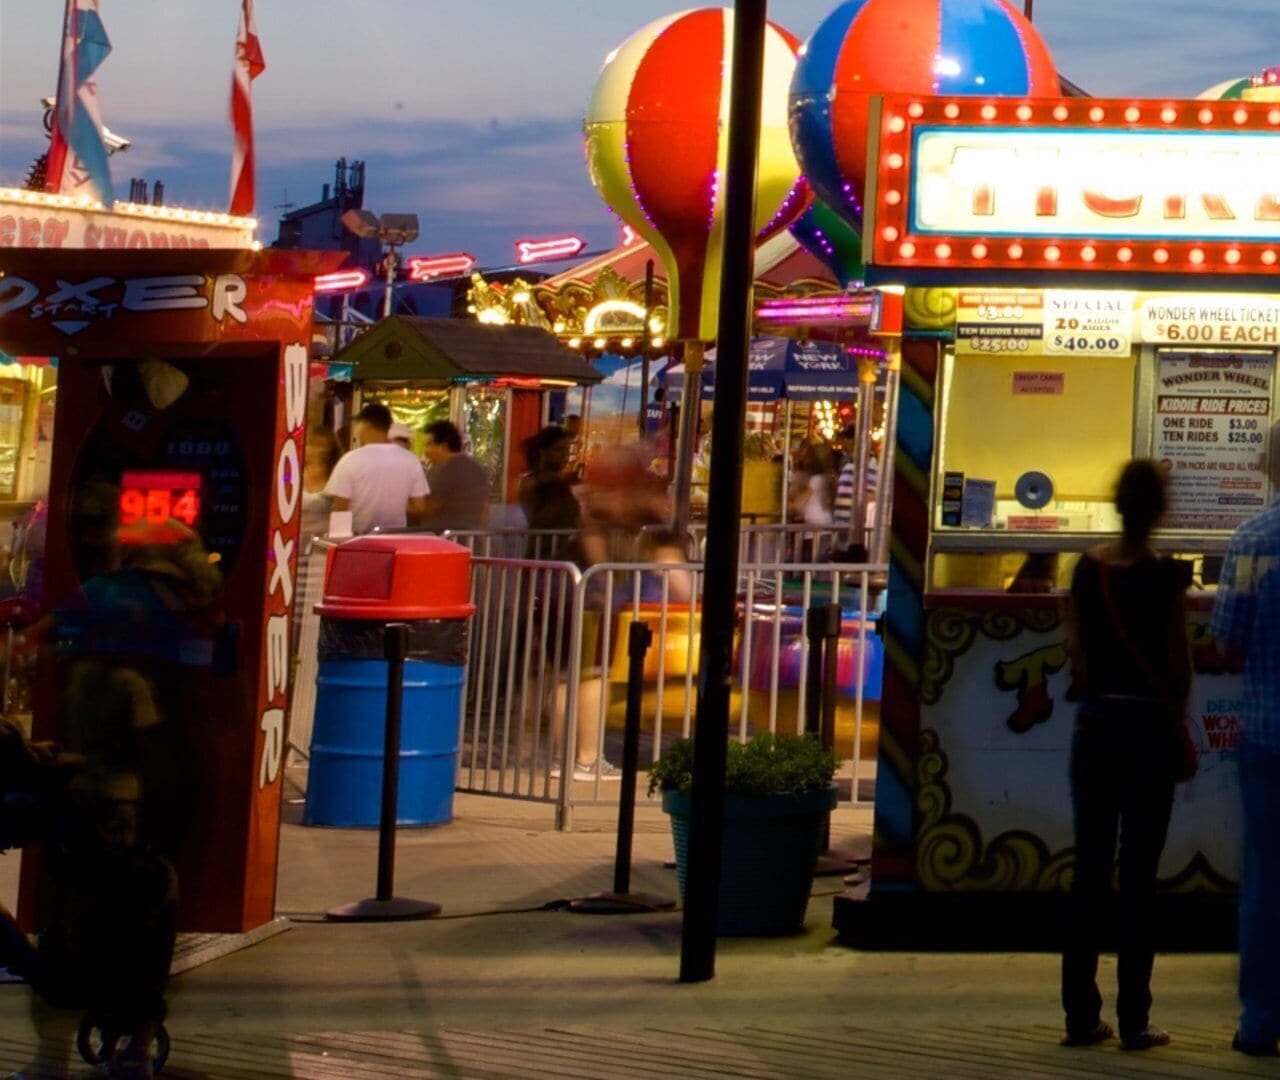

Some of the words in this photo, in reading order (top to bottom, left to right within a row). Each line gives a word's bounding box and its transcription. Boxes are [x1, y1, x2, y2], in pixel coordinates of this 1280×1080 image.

[1052, 299, 1123, 311] SPECIAL
[1148, 306, 1196, 321] WONDER
[1199, 307, 1237, 322] WHEEL
[1055, 317, 1079, 330] 20
[960, 327, 979, 335] TEN
[979, 327, 1013, 336] KIDDIE
[1013, 328, 1041, 336] RIDES
[1156, 323, 1214, 341] $6.00
[1219, 325, 1278, 342] EACH
[970, 336, 1029, 352] $25.00
[1054, 334, 1119, 351] $40.00
[793, 353, 838, 362] NEW
[798, 361, 843, 370] YORK
[1162, 371, 1220, 388] WONDER
[1224, 371, 1269, 391] WHEEL
[1160, 398, 1199, 411] KIDDIE
[1200, 399, 1227, 412] RIDE
[1227, 399, 1268, 413] PRICES
[1163, 417, 1185, 428] ONE
[1188, 418, 1214, 429] RIDE
[1229, 419, 1258, 430] $3.00
[1163, 431, 1185, 442] TEN
[1187, 431, 1219, 442] RIDES
[1228, 432, 1263, 444] $25.00
[1207, 699, 1241, 713] DEN
[1201, 715, 1239, 731] WON
